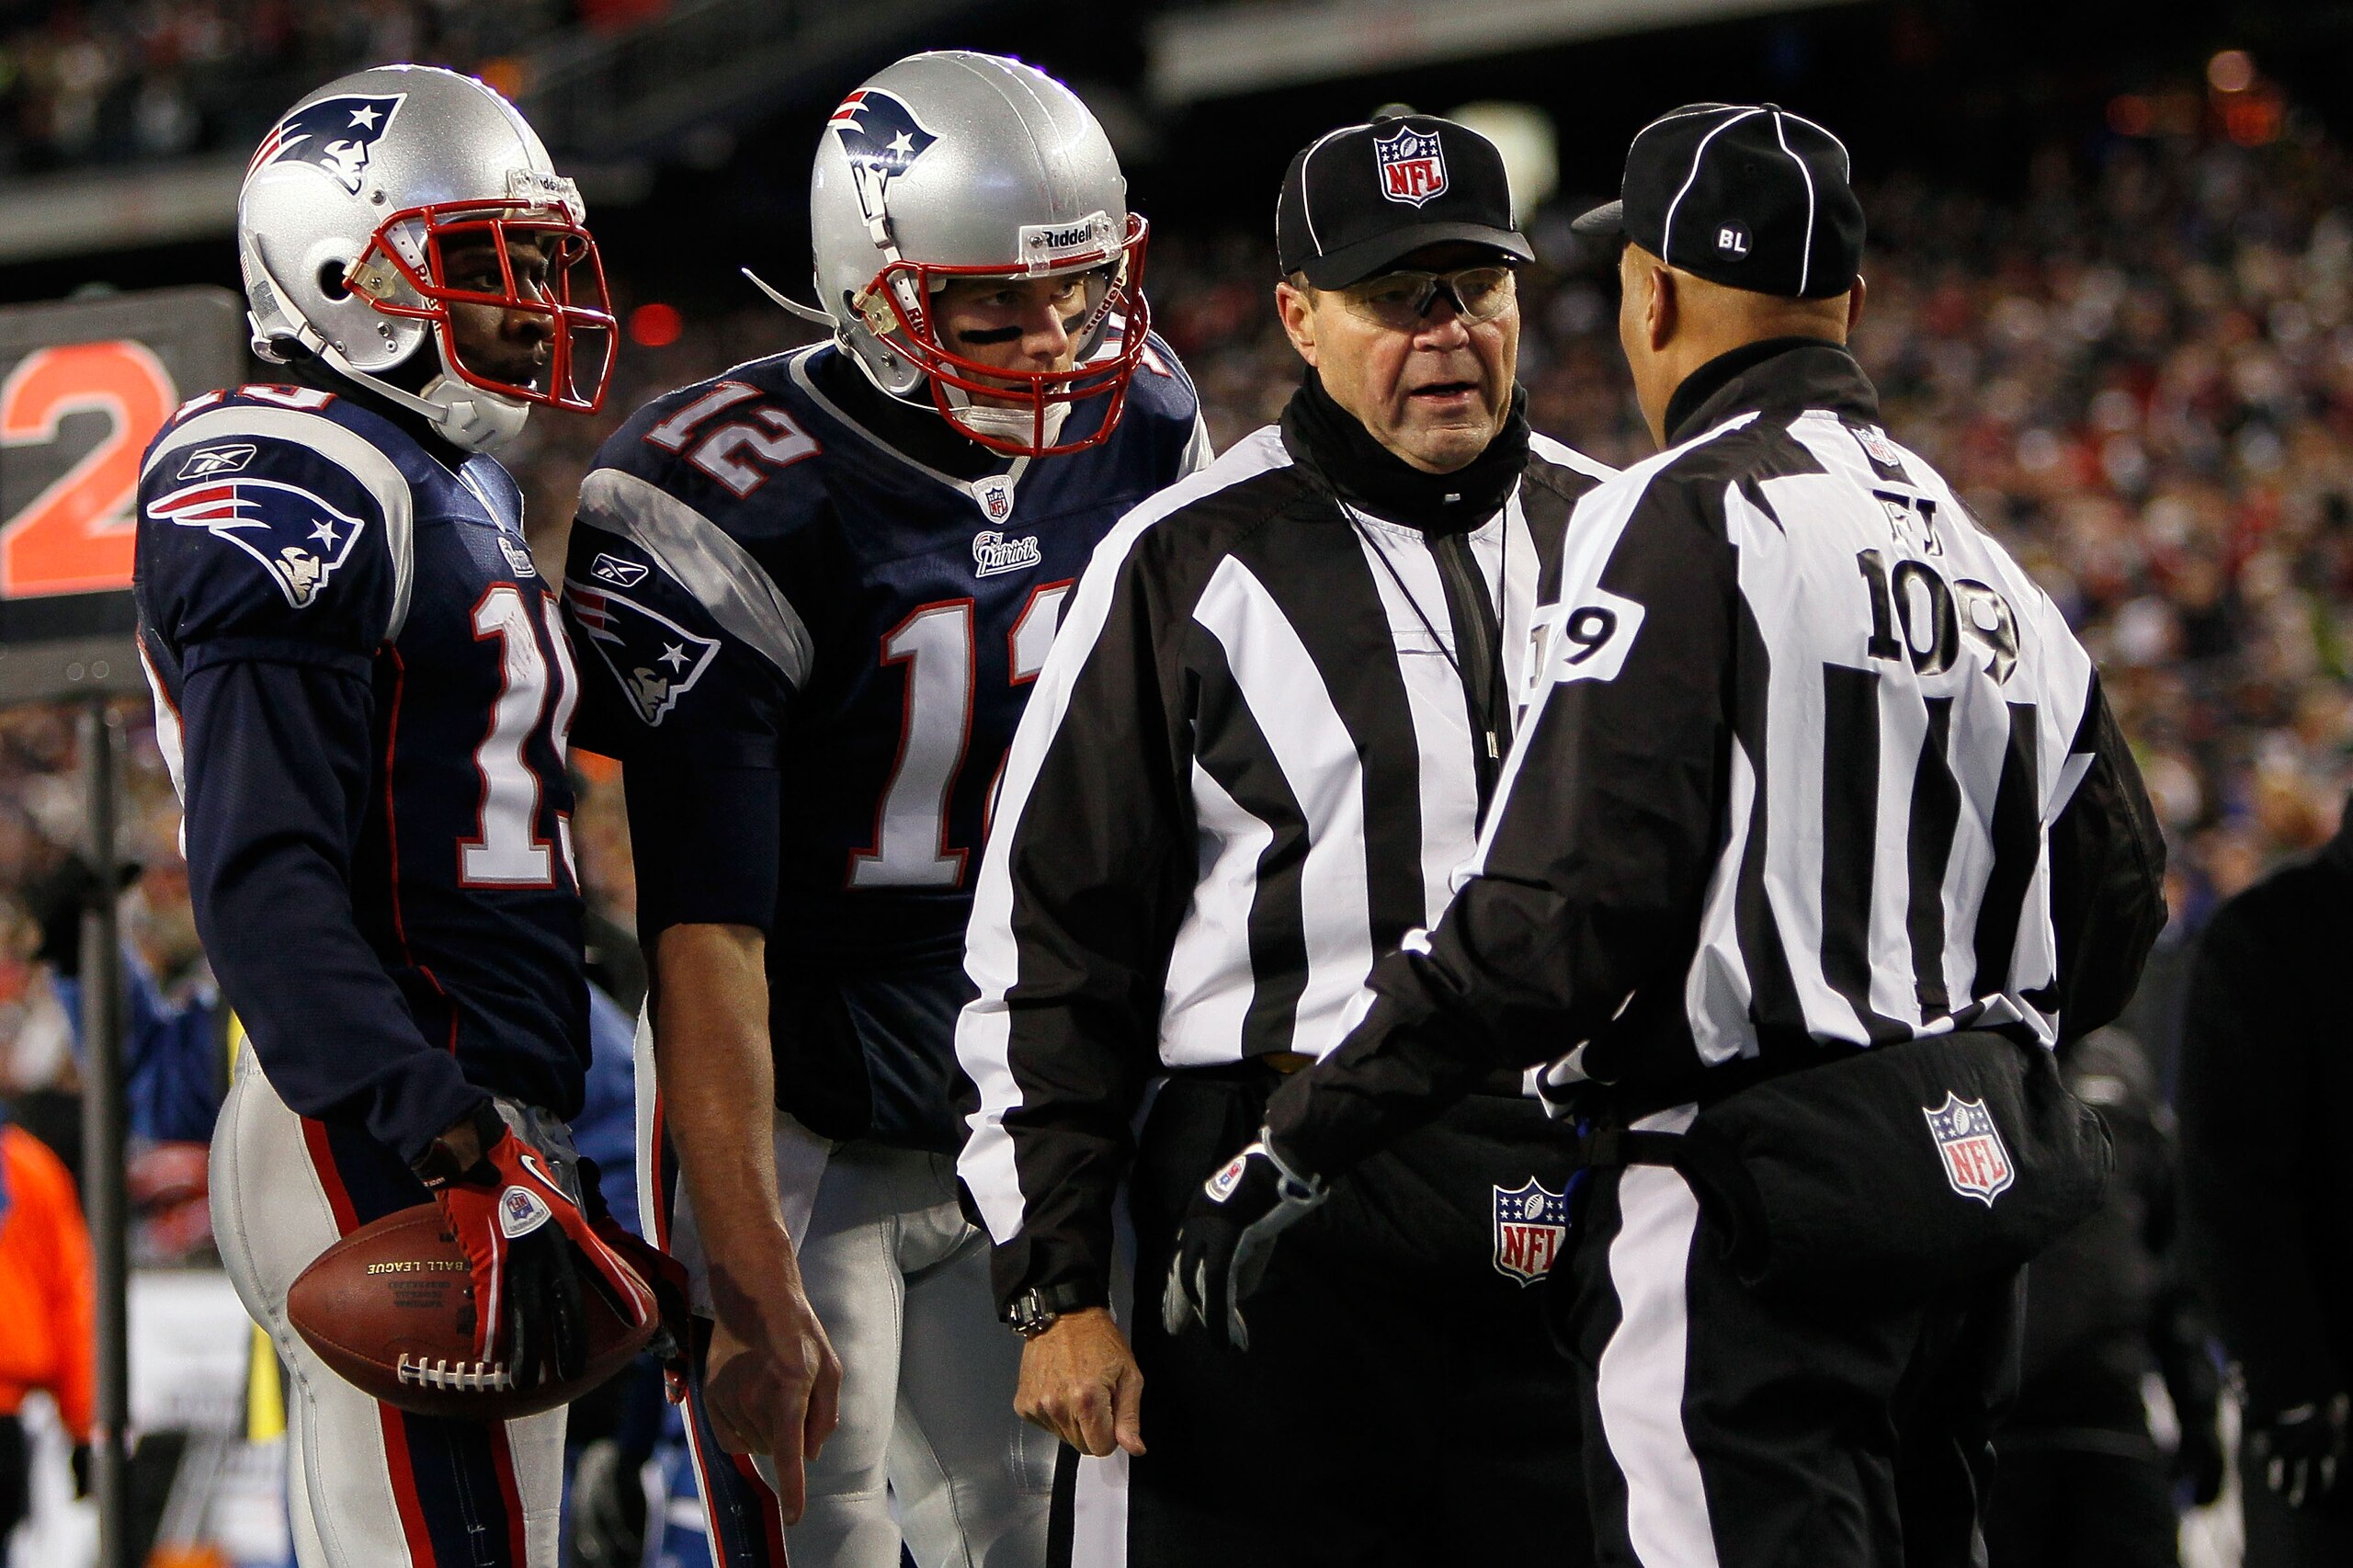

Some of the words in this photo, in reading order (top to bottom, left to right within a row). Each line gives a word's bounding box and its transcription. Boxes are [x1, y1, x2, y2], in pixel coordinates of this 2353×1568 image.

[1385, 159, 1441, 197] NFL
[1042, 222, 1092, 248] Riddell
[1719, 229, 1746, 253] BL
[641, 381, 824, 500] 12
[0, 338, 181, 600] 2
[990, 500, 1008, 516] NFL
[973, 532, 1041, 576] Patriots
[1856, 548, 2020, 687] 109
[455, 581, 583, 896] 1
[1946, 1139, 2007, 1188] NFL
[367, 1261, 420, 1275] LEAGUE
